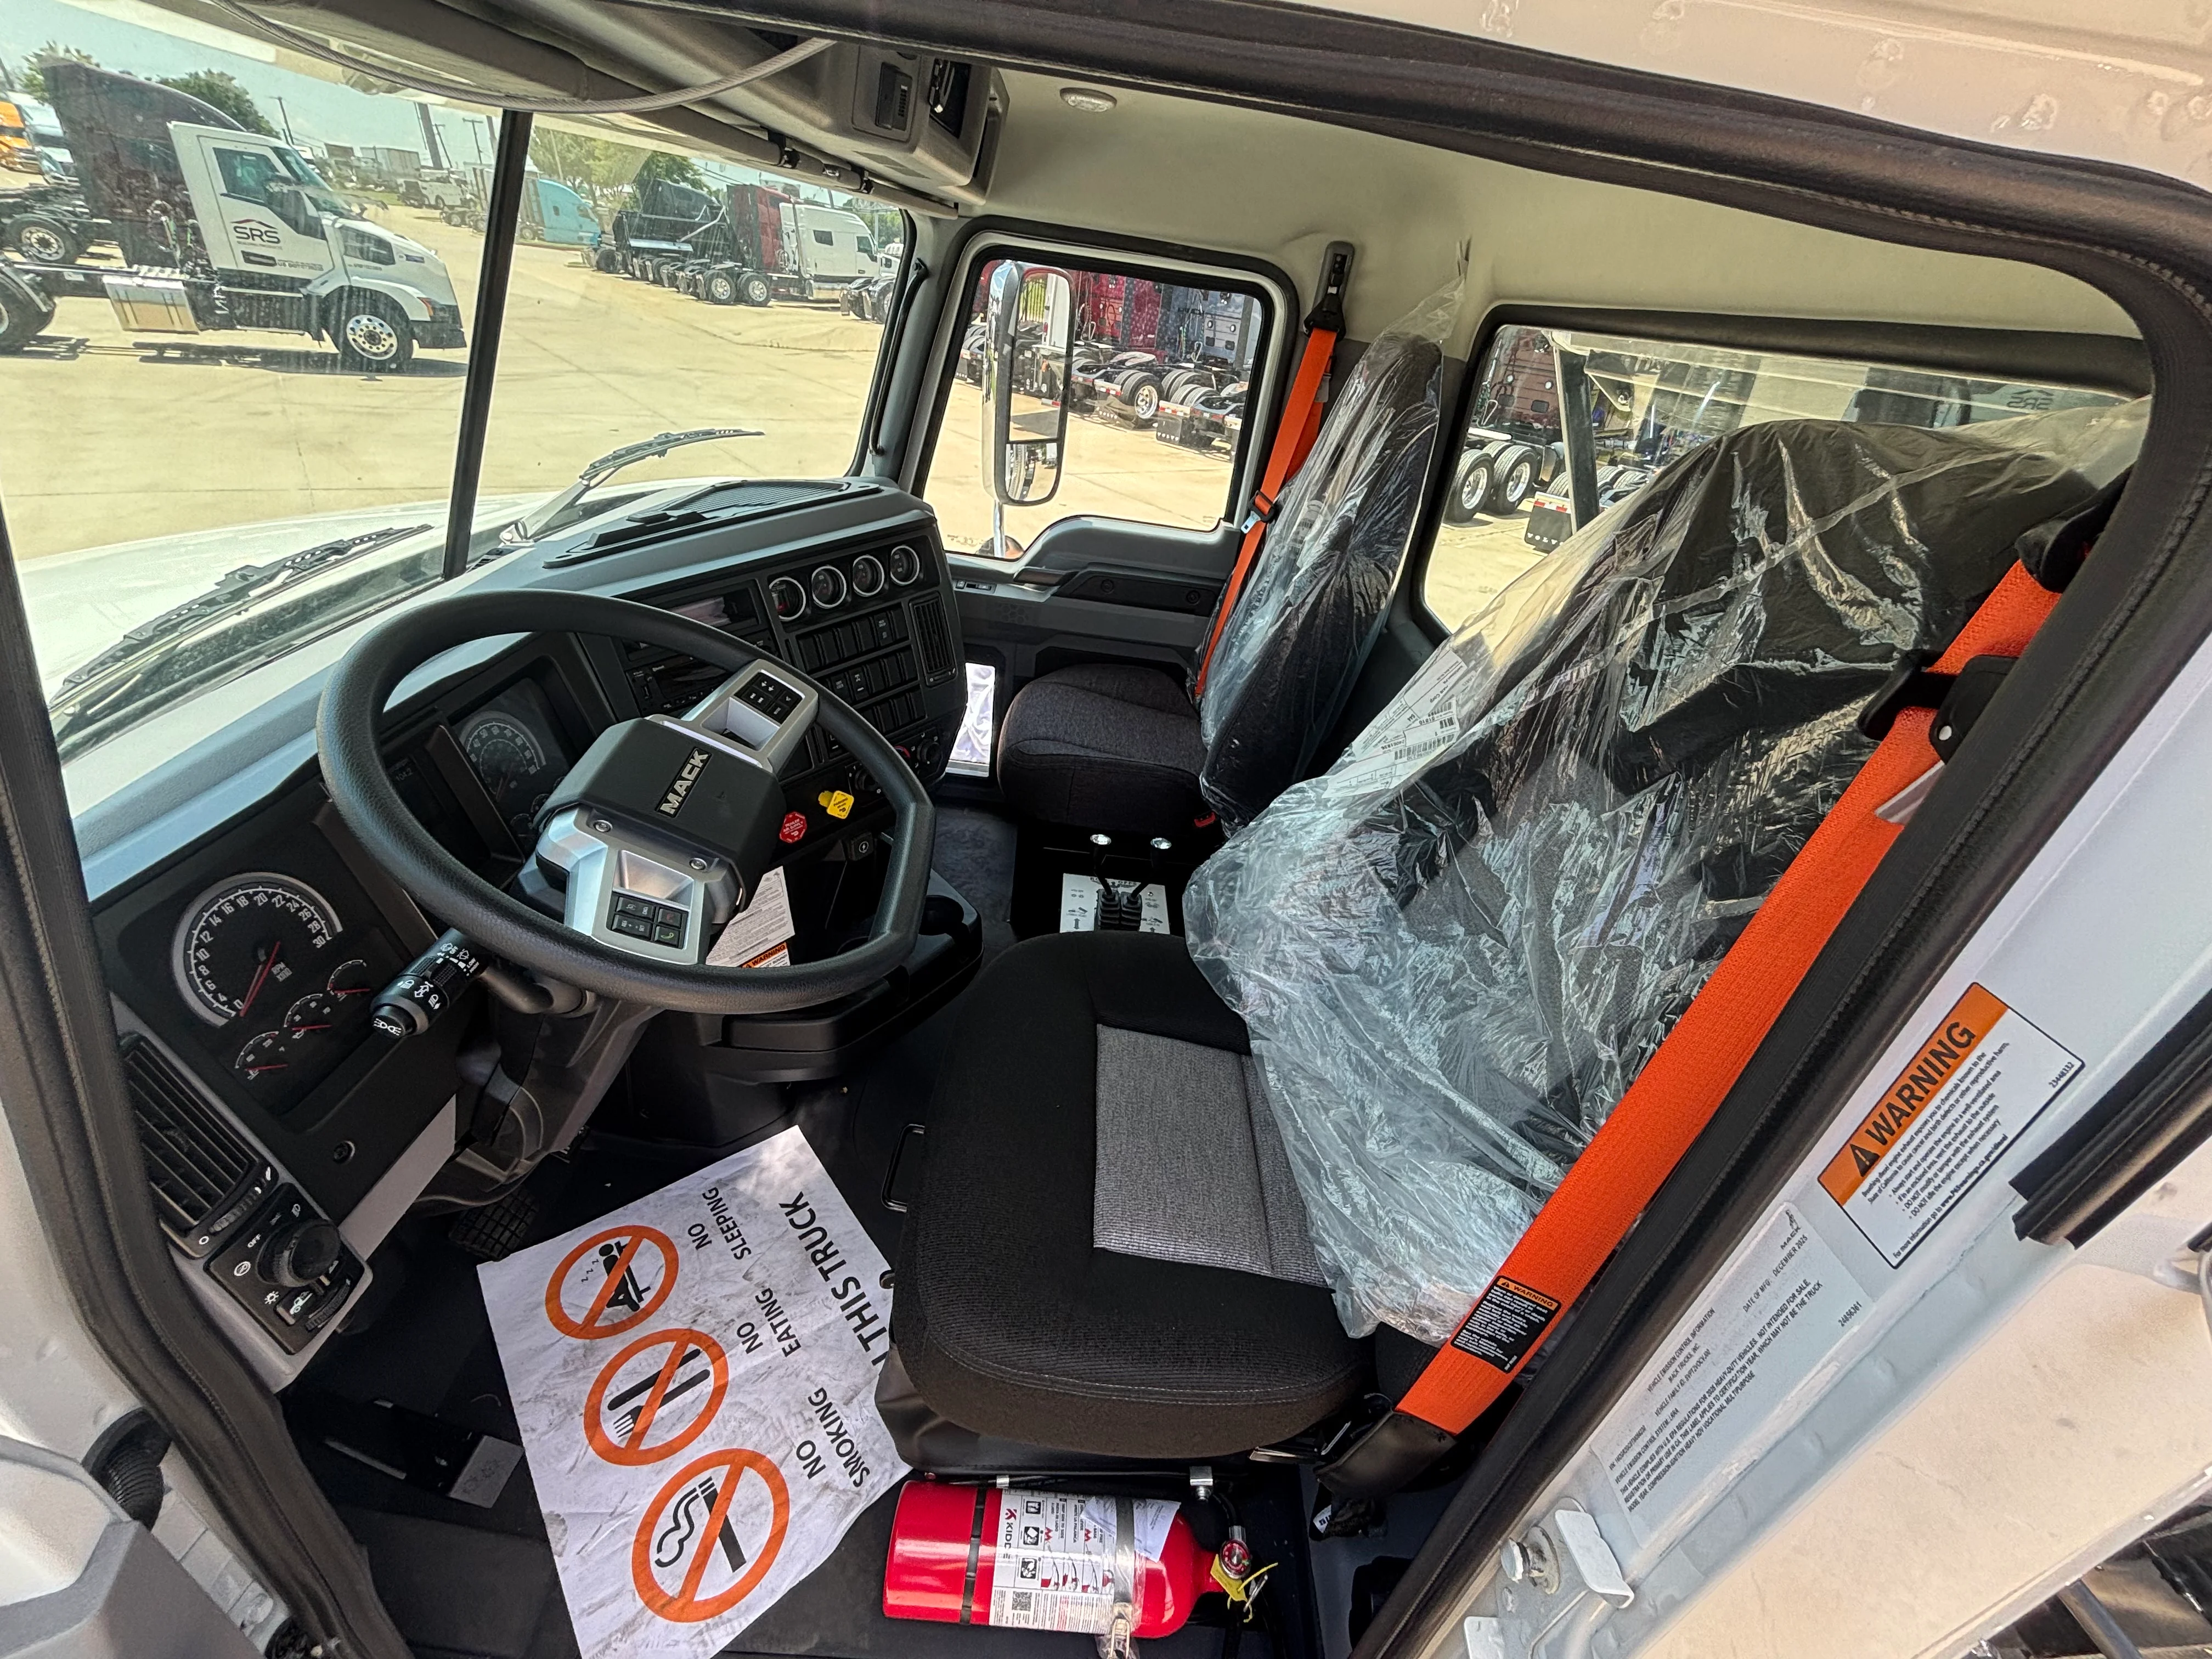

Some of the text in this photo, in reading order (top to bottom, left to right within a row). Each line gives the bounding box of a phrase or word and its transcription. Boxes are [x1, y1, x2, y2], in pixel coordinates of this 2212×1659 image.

[233, 225, 281, 244] SRS
[1527, 532, 1564, 546] VOLVO
[660, 750, 708, 814] MACK
[221, 902, 235, 915] 16
[236, 895, 250, 907] 18
[253, 892, 268, 906] 20
[271, 894, 286, 908] 22
[286, 899, 300, 913] 24
[208, 915, 223, 927] 14
[298, 910, 312, 922] 26
[307, 919, 321, 933] 28
[199, 930, 214, 944] 12
[312, 935, 326, 949] 30
[195, 948, 211, 961] 10
[466, 957, 476, 969] LOW
[752, 945, 786, 966] WARNING
[198, 965, 211, 976] 8
[204, 980, 216, 990] 6
[217, 992, 228, 1002] 4
[1864, 1022, 1977, 1146] WARNING
[1888, 1152, 1902, 1167] engine
[1900, 1135, 1916, 1153] exhaust
[1928, 1109, 1937, 1120] you
[1940, 1082, 1960, 1105] chemicals
[1976, 1052, 1986, 1062] the
[1923, 1128, 1933, 1140] and
[1929, 1119, 1942, 1131] birth
[1959, 1085, 1971, 1099] other
[1970, 1056, 1997, 1086] reproductive
[1891, 1179, 1906, 1195] Always
[1904, 1169, 1914, 1181] start
[1912, 1160, 1921, 1171] and
[1933, 1137, 1942, 1146] the
[1940, 1122, 1956, 1139] engine
[1990, 1070, 2001, 1082] area
[1943, 1141, 1953, 1149] the
[1951, 1123, 1968, 1142] exhaust
[1970, 1110, 1980, 1119] the
[1978, 1092, 1995, 1111] outside
[1904, 1199, 1912, 1209] DO
[1910, 1189, 1921, 1202] NOT
[1919, 1176, 1934, 1193] modify
[1950, 1146, 1962, 1157] with
[1959, 1138, 1968, 1147] the
[1967, 1120, 1984, 1139] exhaust
[1982, 1104, 1999, 1122] system
[1910, 1206, 1920, 1216] DO
[1917, 1197, 1928, 1209] NOT
[1933, 1183, 1943, 1192] the
[1940, 1168, 1956, 1184] engine
[1954, 1153, 1970, 1170] except
[1967, 1141, 1980, 1155] when
[1978, 1119, 2001, 1142] necessary
[702, 1187, 752, 1260] SLEEPING
[1892, 1250, 1901, 1258] For
[1930, 1211, 1937, 1220] go
[247, 1234, 261, 1248] OFF
[687, 1223, 712, 1250] NO
[1780, 1225, 1801, 1250] MACK
[778, 1191, 888, 1352] THIS TRUCK
[1742, 1297, 1756, 1312] DATE
[1753, 1289, 1760, 1299] OF
[1772, 1246, 1798, 1277] DECEMBER
[1795, 1234, 1808, 1249] 2025
[1514, 1285, 1554, 1308] WARNING
[755, 1288, 802, 1358] EATING
[1757, 1325, 1767, 1339] NOT
[1765, 1303, 1788, 1329] INTENDED
[1786, 1292, 1798, 1306] FOR
[736, 1322, 764, 1355] NO
[1712, 1394, 1720, 1403] TO
[1757, 1335, 1773, 1353] WHICH
[1770, 1325, 1781, 1338] MAY
[1780, 1314, 1791, 1328] NOT
[1789, 1307, 1798, 1318] BE
[1795, 1297, 1807, 1310] THE
[1804, 1280, 1822, 1300] TRUCK
[808, 1387, 871, 1487] SMOKING
[796, 1440, 826, 1480] NO
